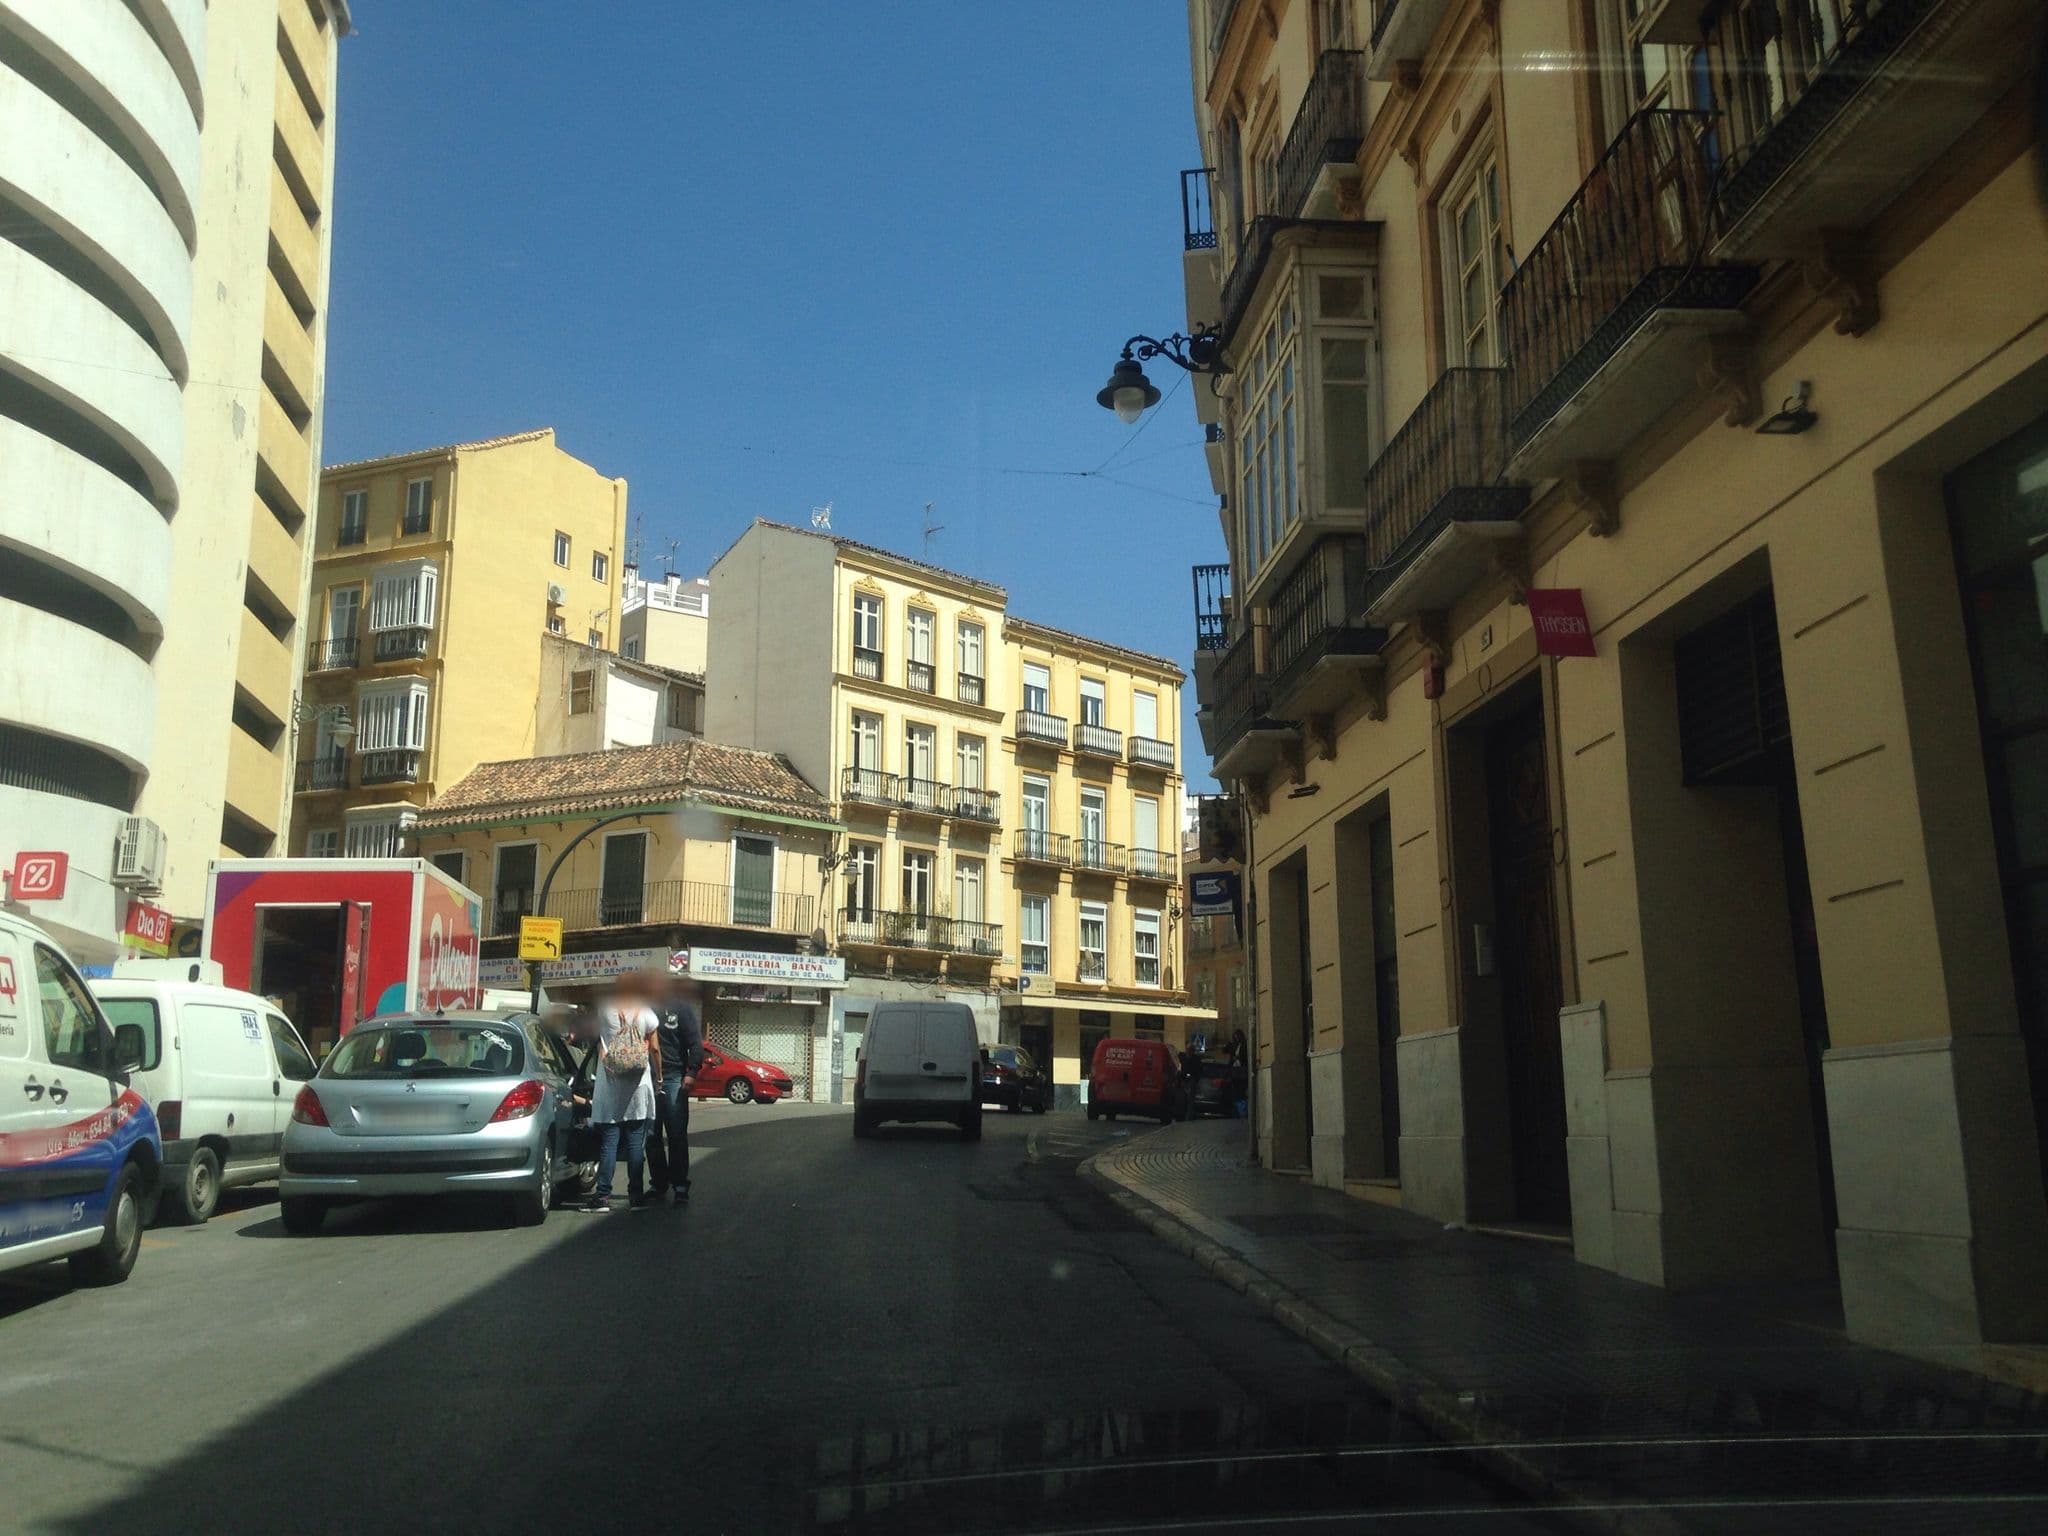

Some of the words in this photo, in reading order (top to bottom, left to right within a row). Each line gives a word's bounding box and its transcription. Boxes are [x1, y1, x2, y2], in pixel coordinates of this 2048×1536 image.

[1536, 616, 1586, 633] THYSSEN
[714, 957, 780, 969] CRISTALERIA
[791, 962, 823, 972] BAENA
